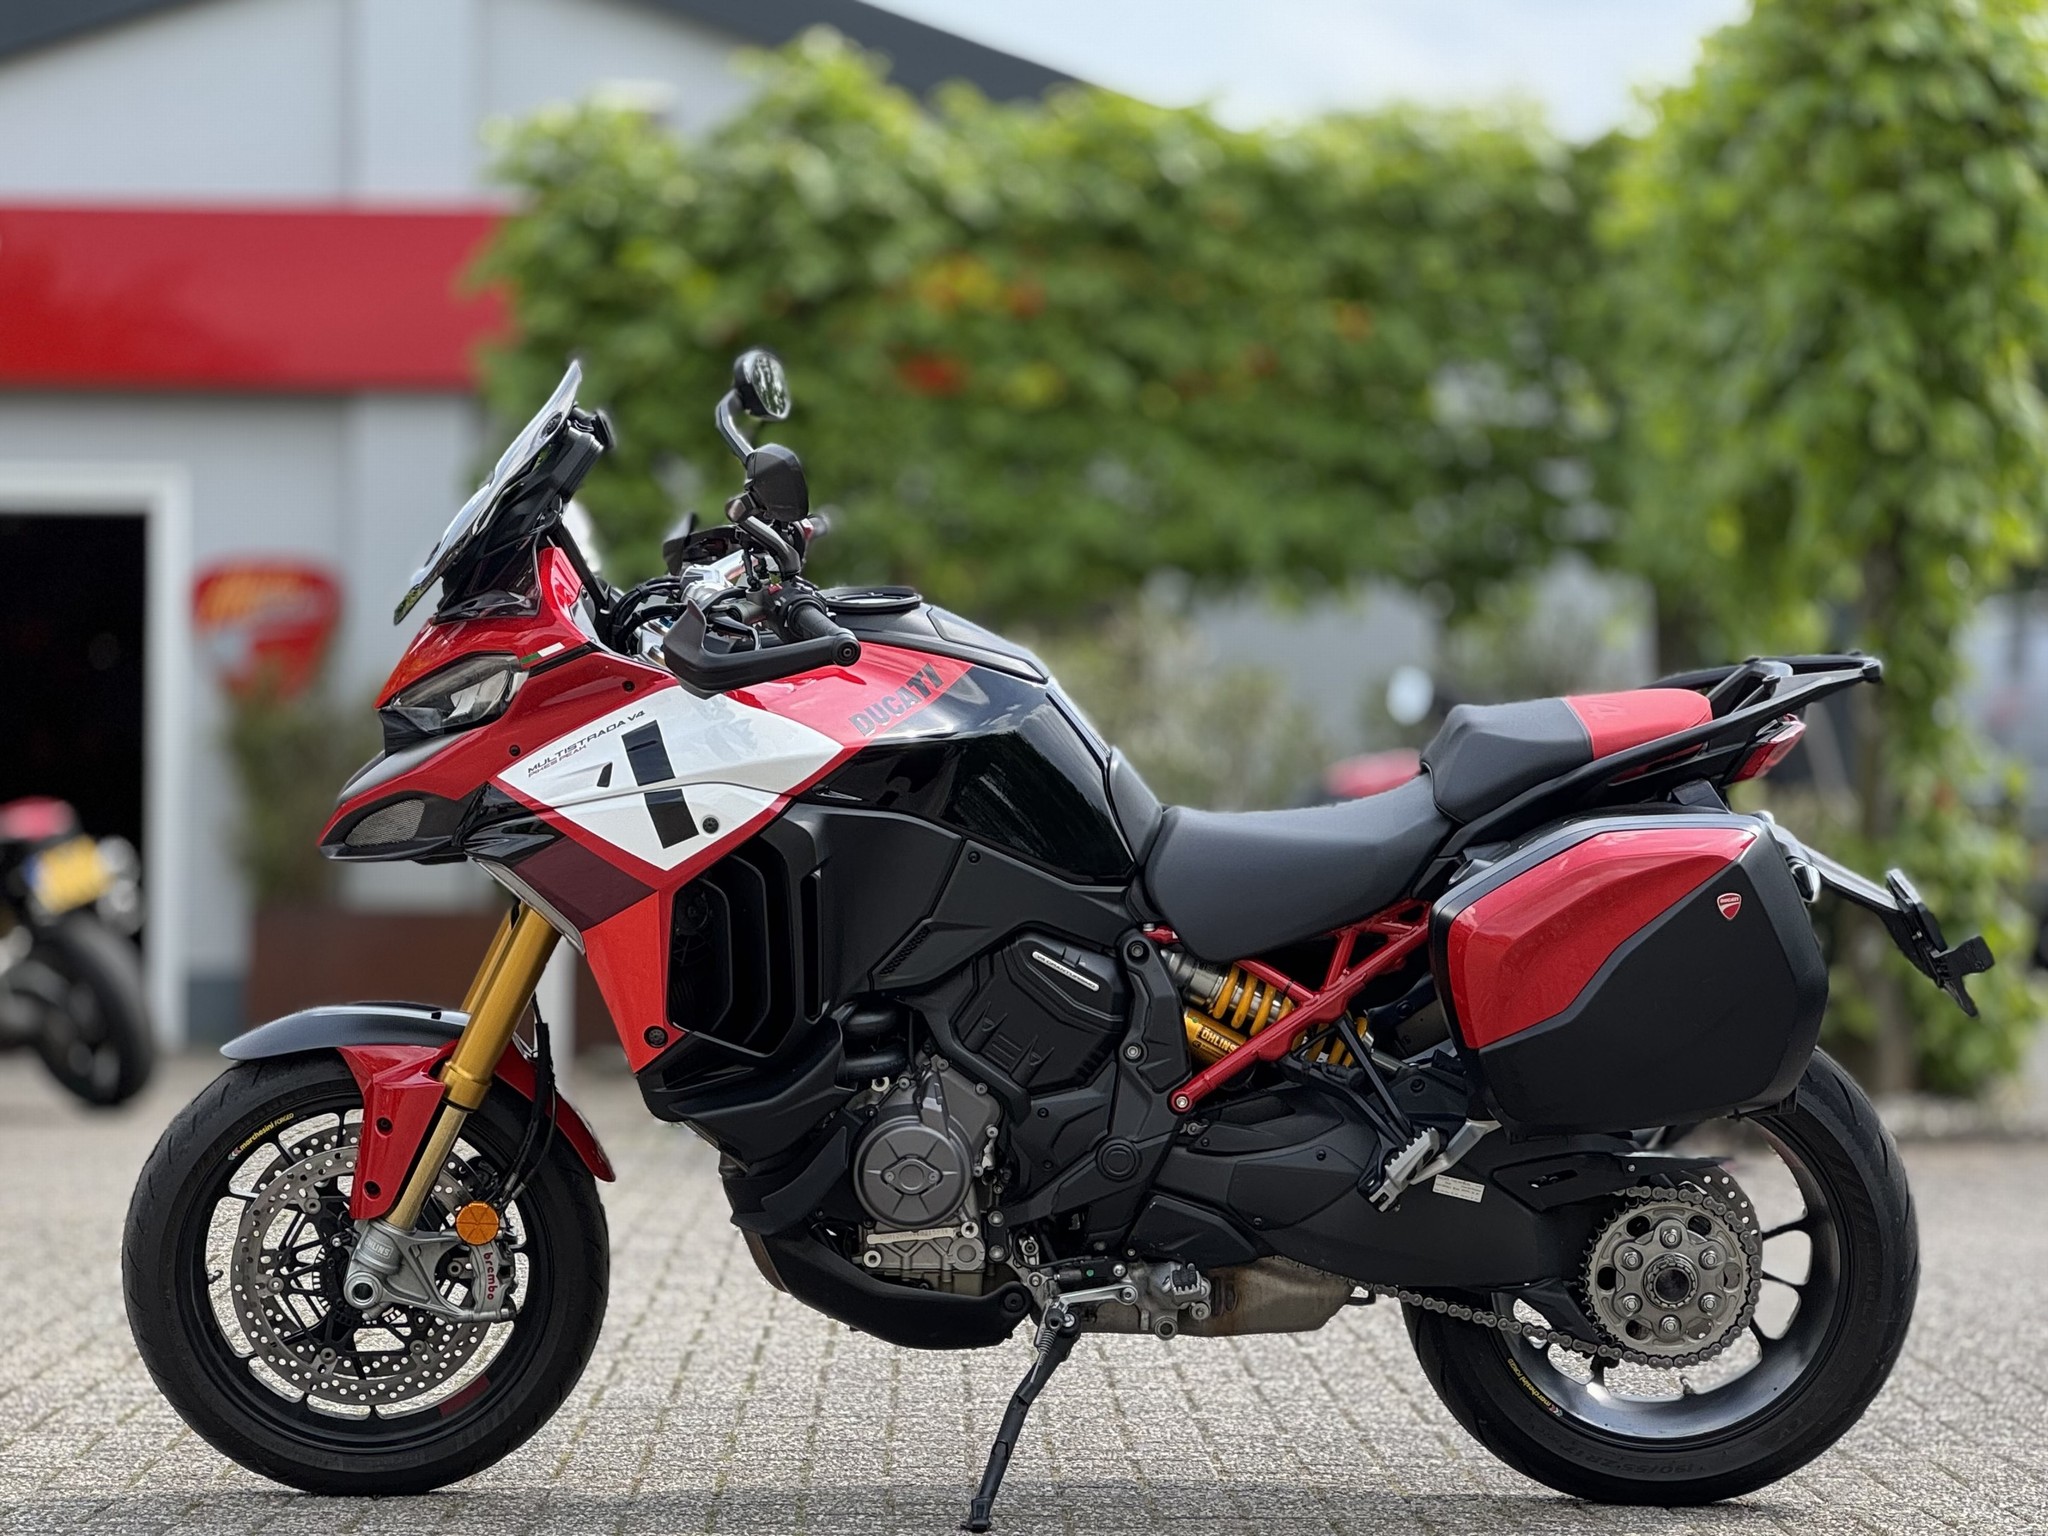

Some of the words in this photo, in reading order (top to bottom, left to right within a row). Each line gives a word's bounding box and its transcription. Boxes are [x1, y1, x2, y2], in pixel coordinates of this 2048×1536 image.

[847, 662, 944, 738] DUCATI
[527, 720, 626, 774] MULTISTRADA
[627, 710, 646, 721] V4
[559, 744, 587, 762] PEAK
[1200, 1026, 1238, 1054] ÖHLINS
[239, 1121, 275, 1151] marchesini
[483, 1252, 498, 1300] brembo
